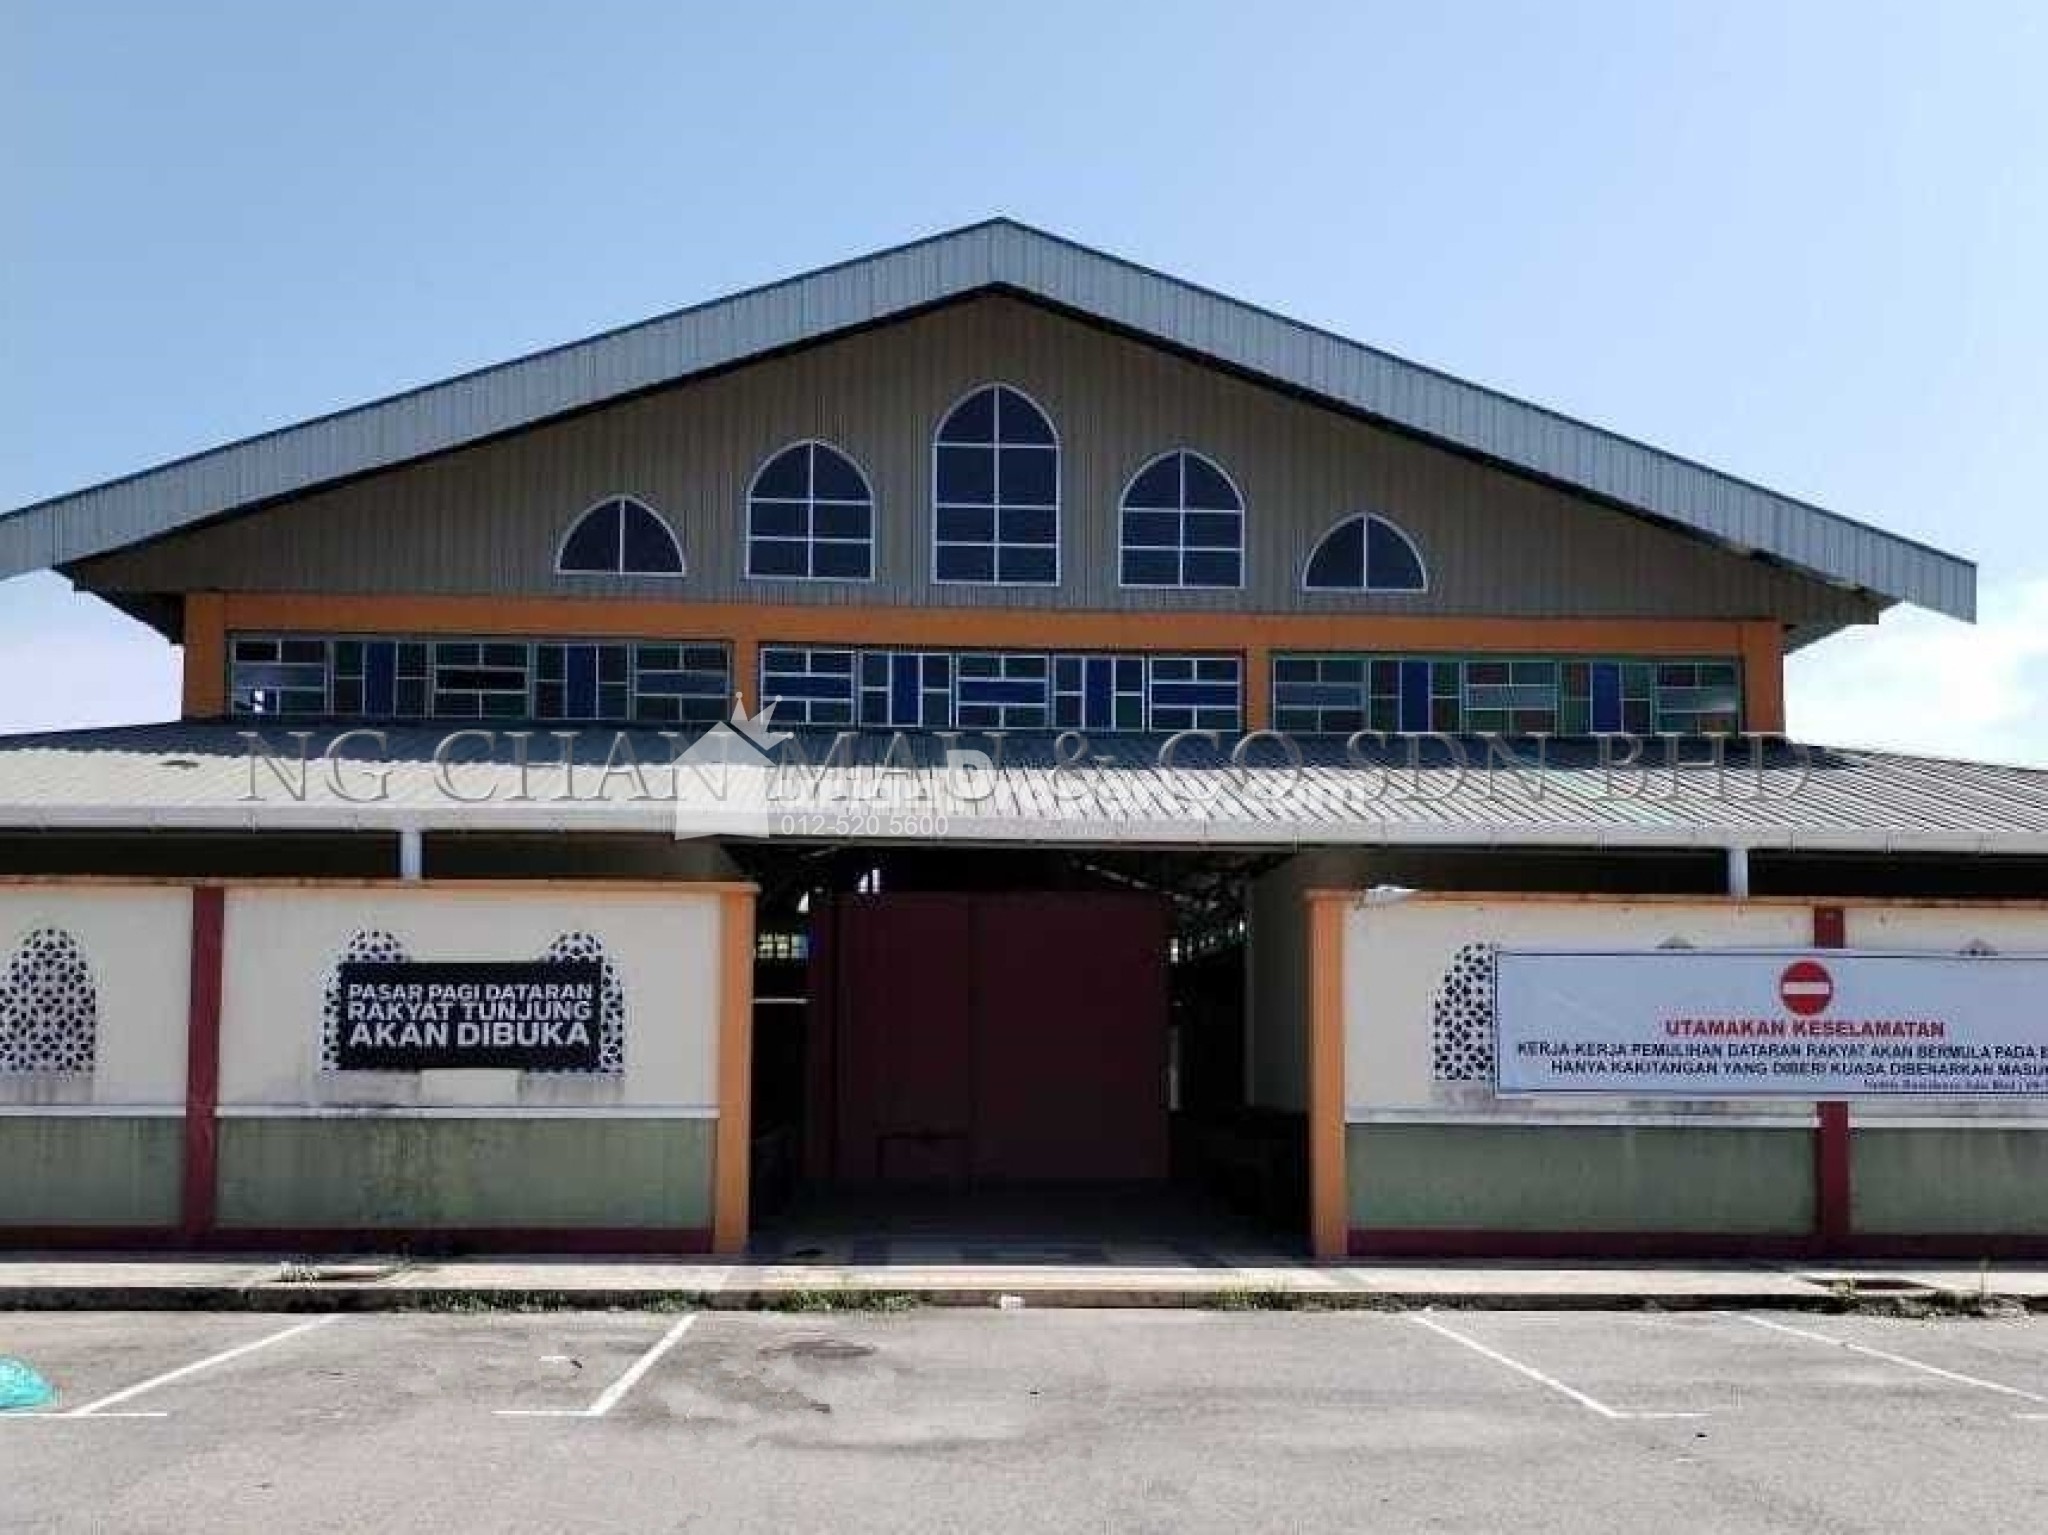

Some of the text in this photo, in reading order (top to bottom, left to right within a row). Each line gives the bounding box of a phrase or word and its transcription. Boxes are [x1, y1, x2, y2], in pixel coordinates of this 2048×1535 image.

[350, 984, 593, 1001] PASAR PAGI DATARAN
[348, 1001, 592, 1021] RAKYAT TUNJUNG
[349, 1022, 591, 1046] AKAN DIBUKA
[1665, 1019, 1945, 1037] UTAMAKAN KESELAMATAN
[1518, 1042, 1627, 1057] KERJA-KERJA
[1632, 1043, 1723, 1057] PEMULIHAN
[1728, 1043, 1801, 1057] DATARAN
[1806, 1043, 1865, 1057] RAKYAT
[1871, 1044, 1913, 1059] AKAN
[1916, 1044, 1990, 1059] BERMULA
[1994, 1045, 2036, 1060] PADA
[1551, 1060, 1608, 1075] HANYA
[1611, 1060, 1718, 1075] KAKITANGAN
[1724, 1062, 1768, 1076] YANG
[1773, 1062, 1827, 1075] DIBERI
[1831, 1062, 1886, 1076] KUASA
[1889, 1062, 1994, 1076] DIBENARKAN
